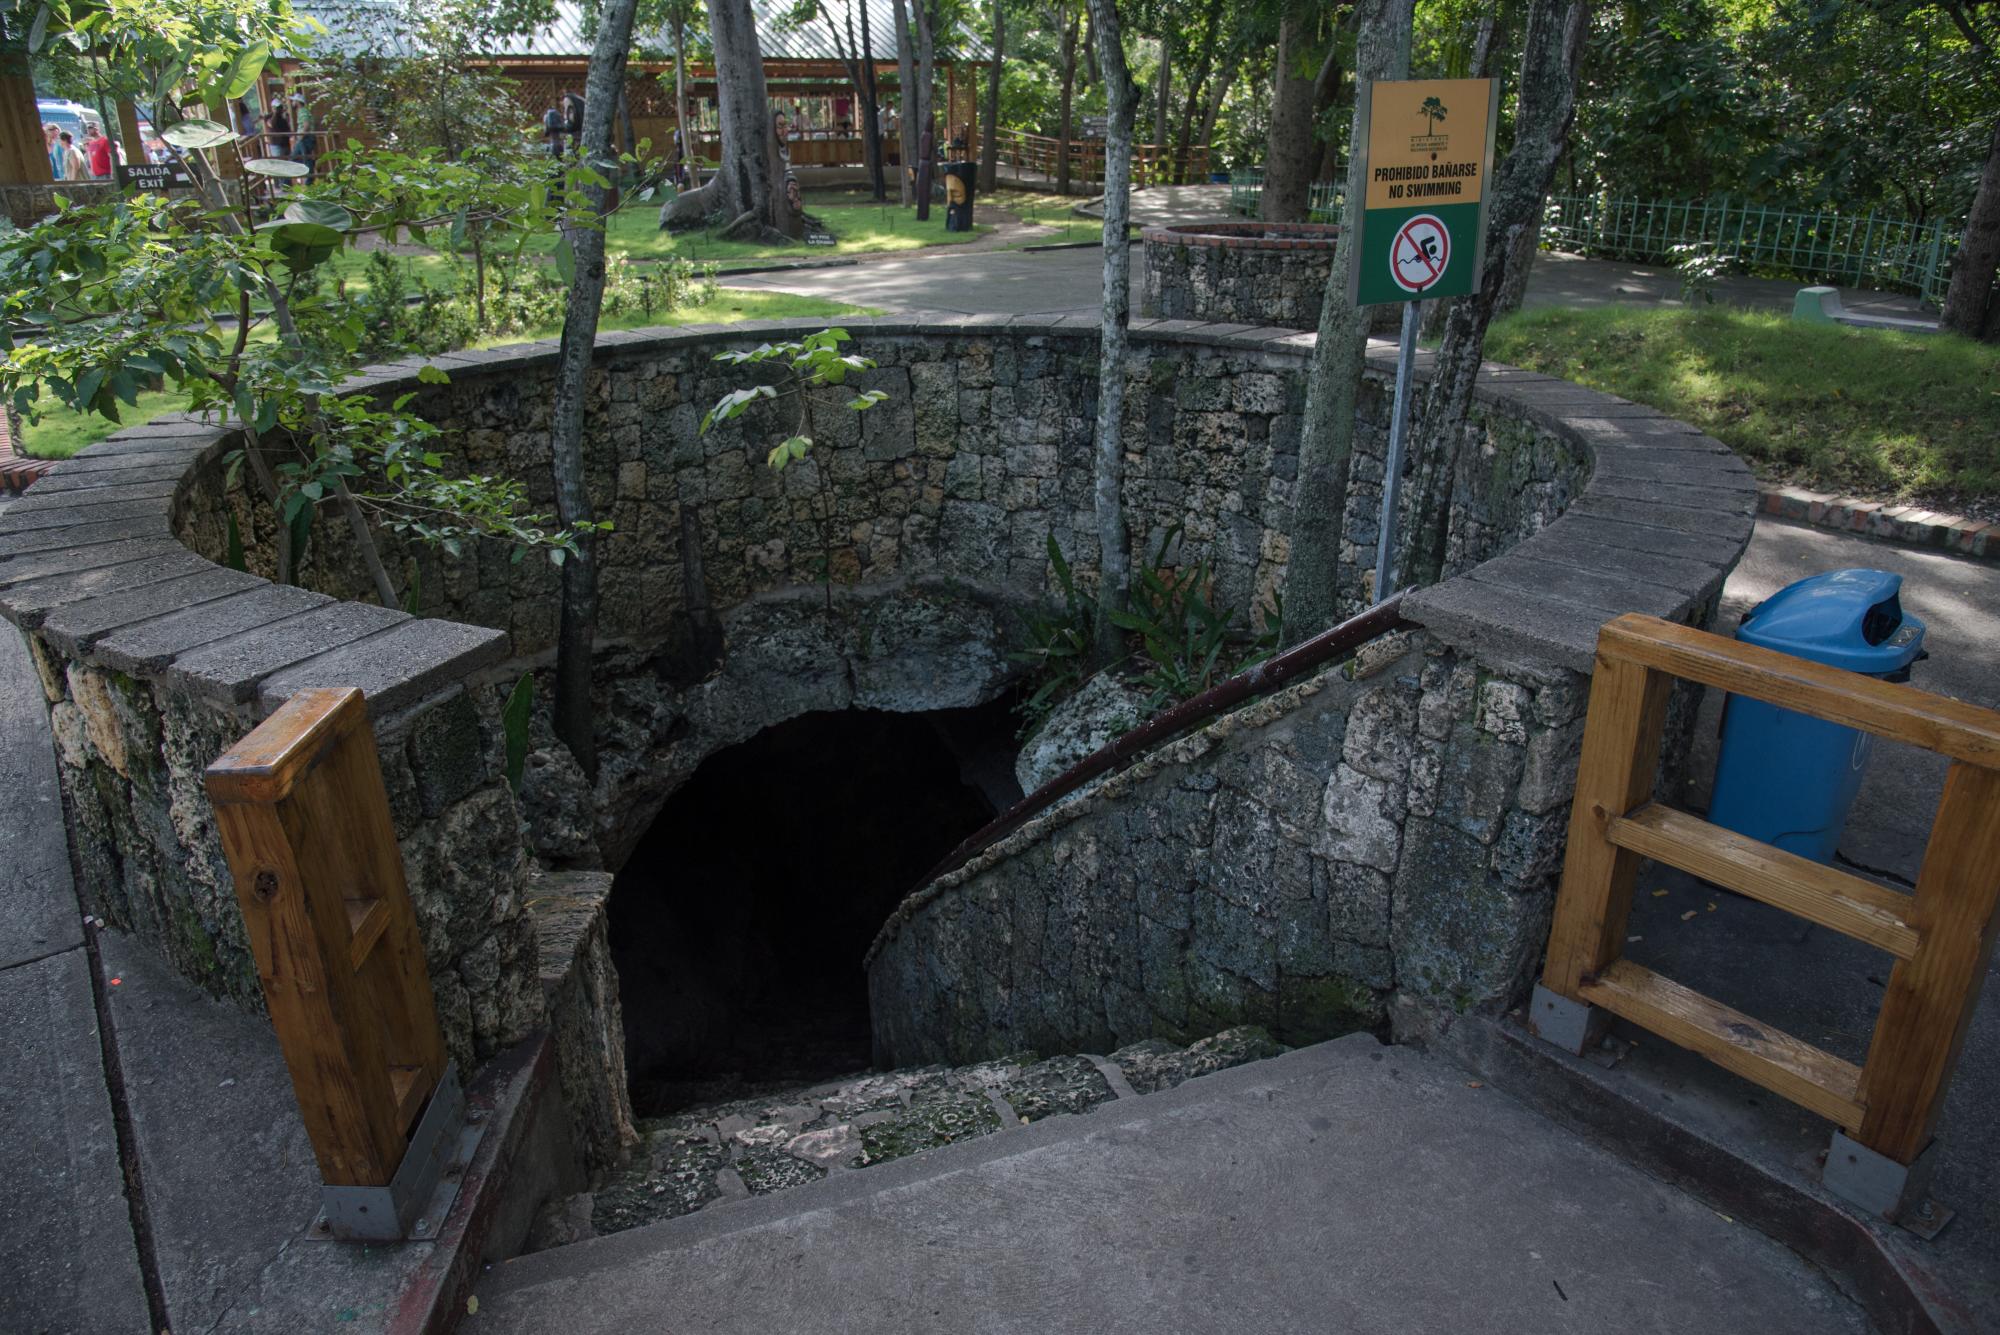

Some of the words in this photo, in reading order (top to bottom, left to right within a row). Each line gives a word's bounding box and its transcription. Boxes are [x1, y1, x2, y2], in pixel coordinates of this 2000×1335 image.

[128, 167, 171, 177] SALIDA
[1374, 165, 1429, 182] PROHIBIDO
[1432, 162, 1477, 178] BAÑARSE
[138, 178, 164, 188] EXIT
[1388, 185, 1404, 199] NO
[1406, 181, 1461, 197] SWIMMING
